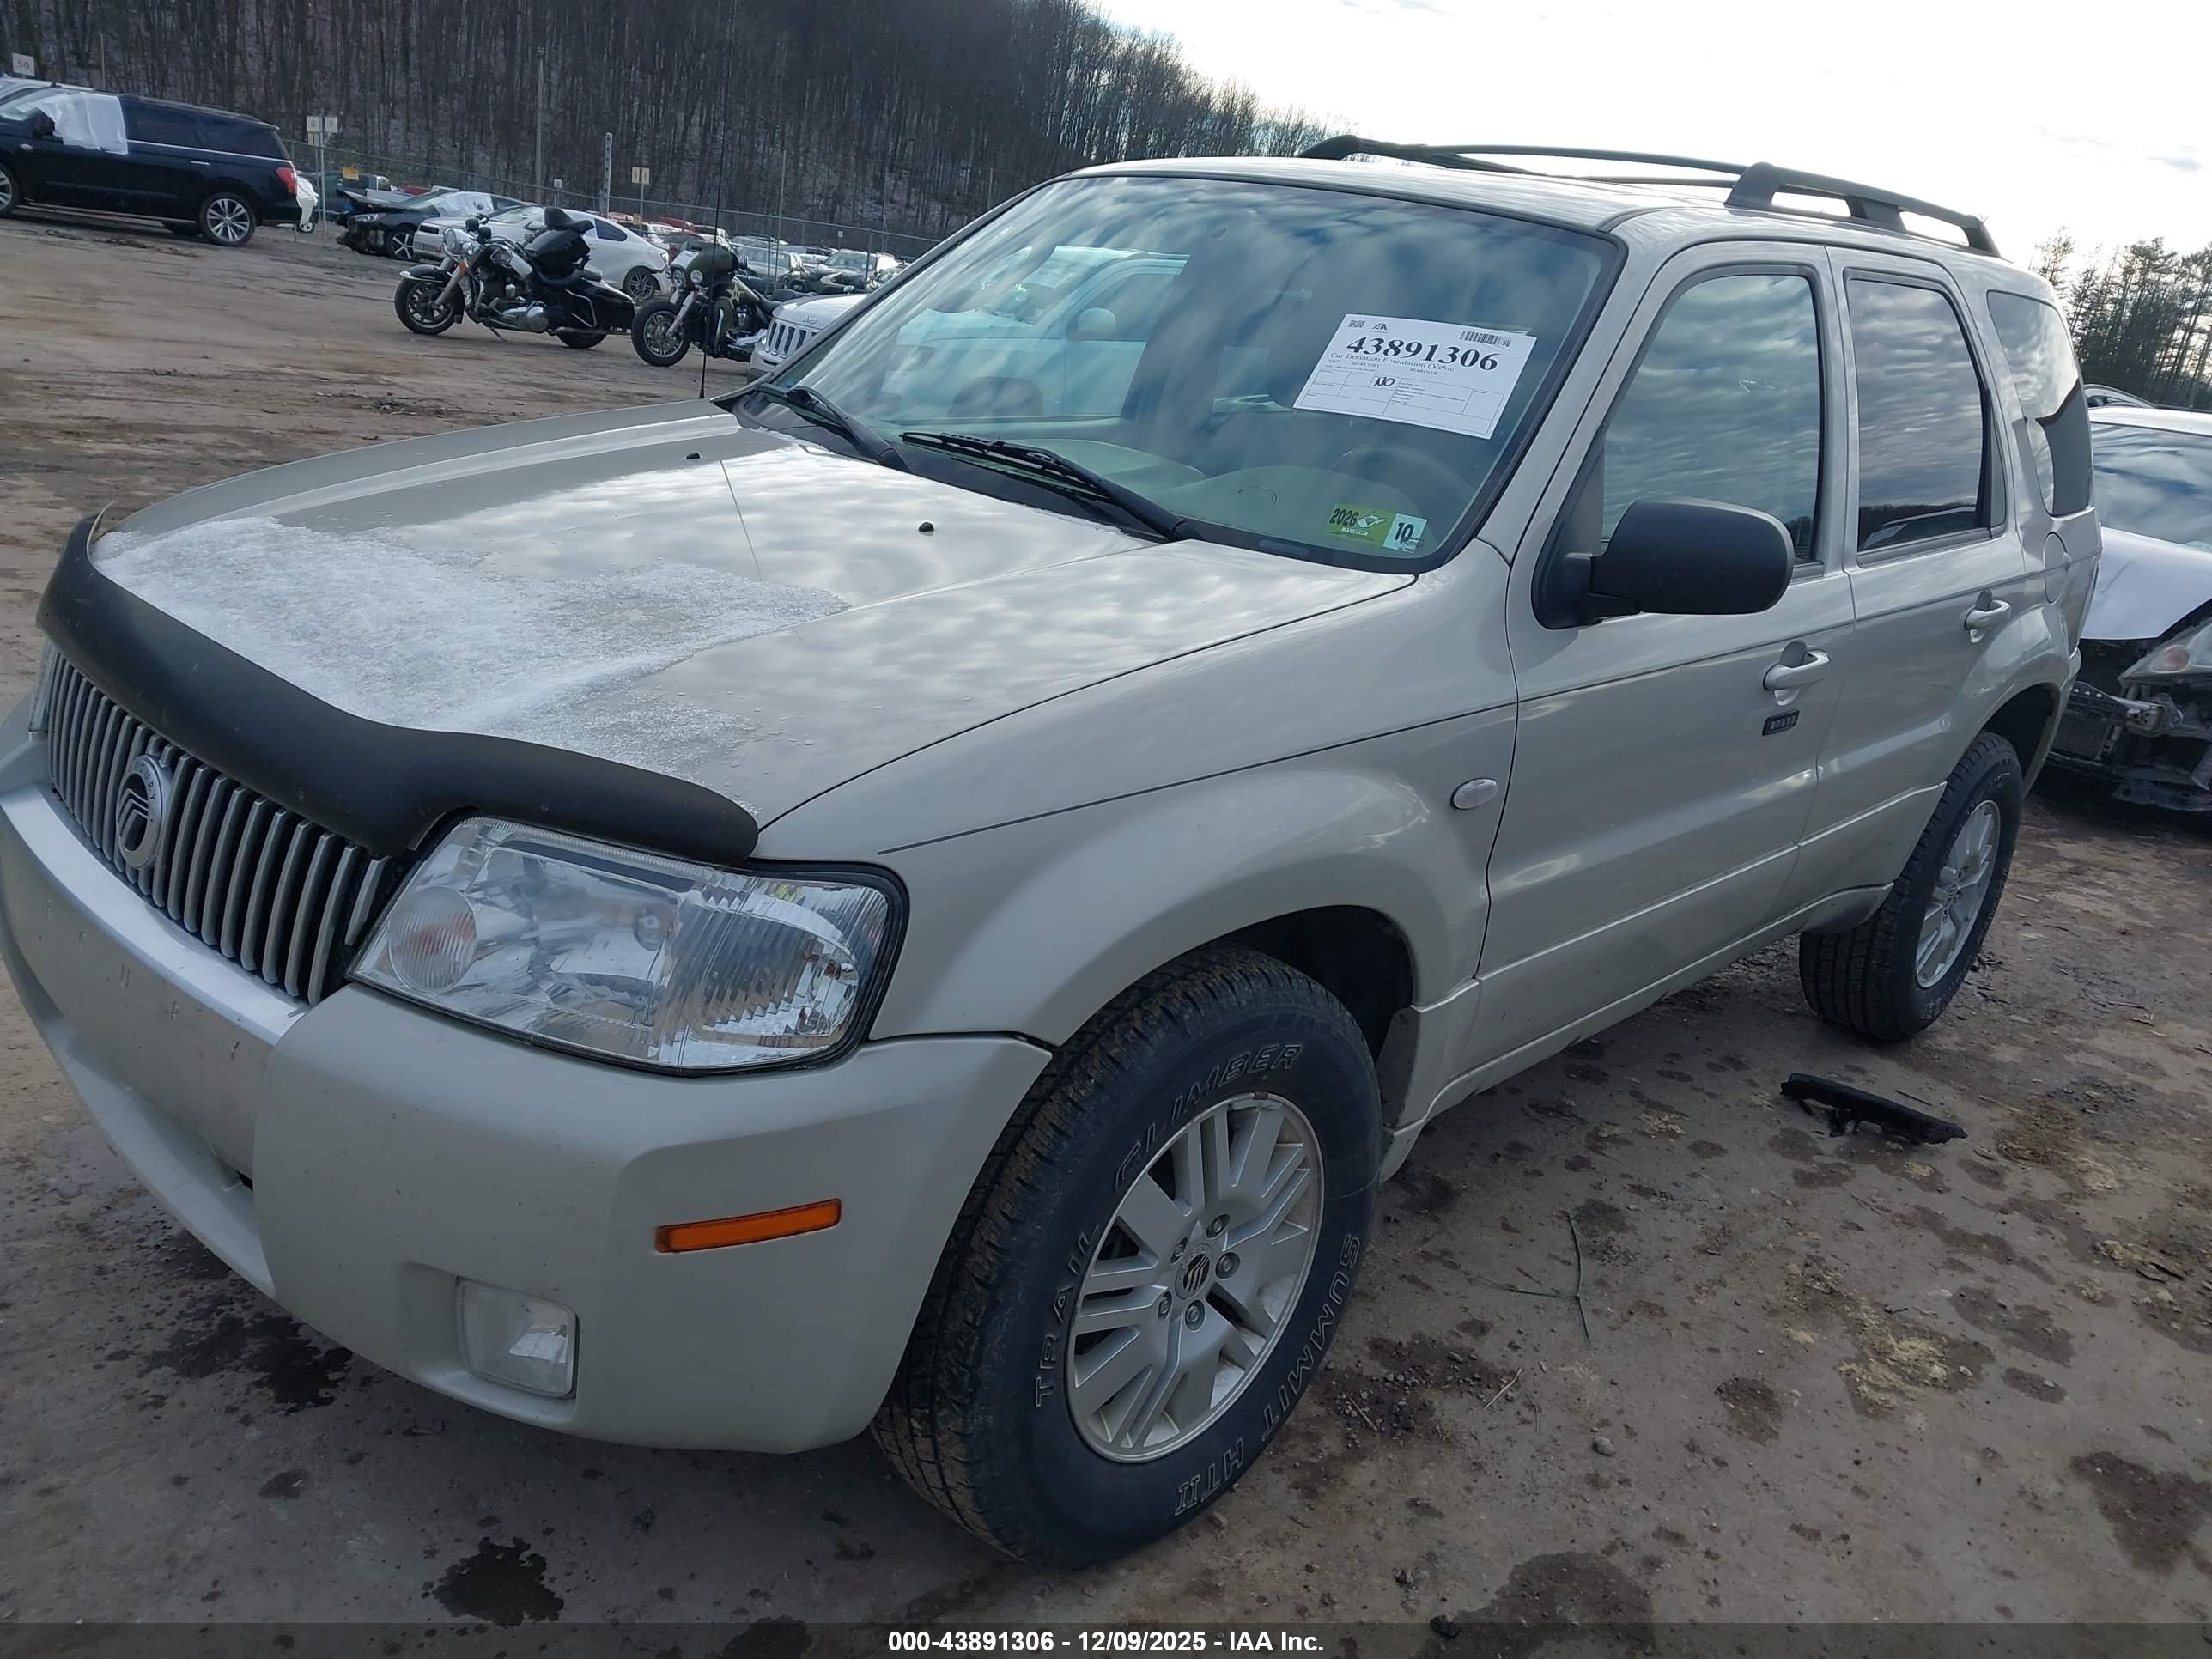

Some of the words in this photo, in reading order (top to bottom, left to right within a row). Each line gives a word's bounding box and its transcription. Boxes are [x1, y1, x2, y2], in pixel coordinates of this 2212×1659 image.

[1346, 336, 1502, 371] 43891306
[1346, 353, 1381, 362] Donation
[1382, 356, 1426, 369] Foundation
[1410, 368, 1438, 376] MARINER
[1329, 507, 1358, 527] 2026
[1394, 521, 1414, 542] 10
[1036, 1223, 1099, 1407] TRAIL
[1115, 1043, 1304, 1188] CLIMBER
[1261, 1233, 1361, 1443] SUMMIT
